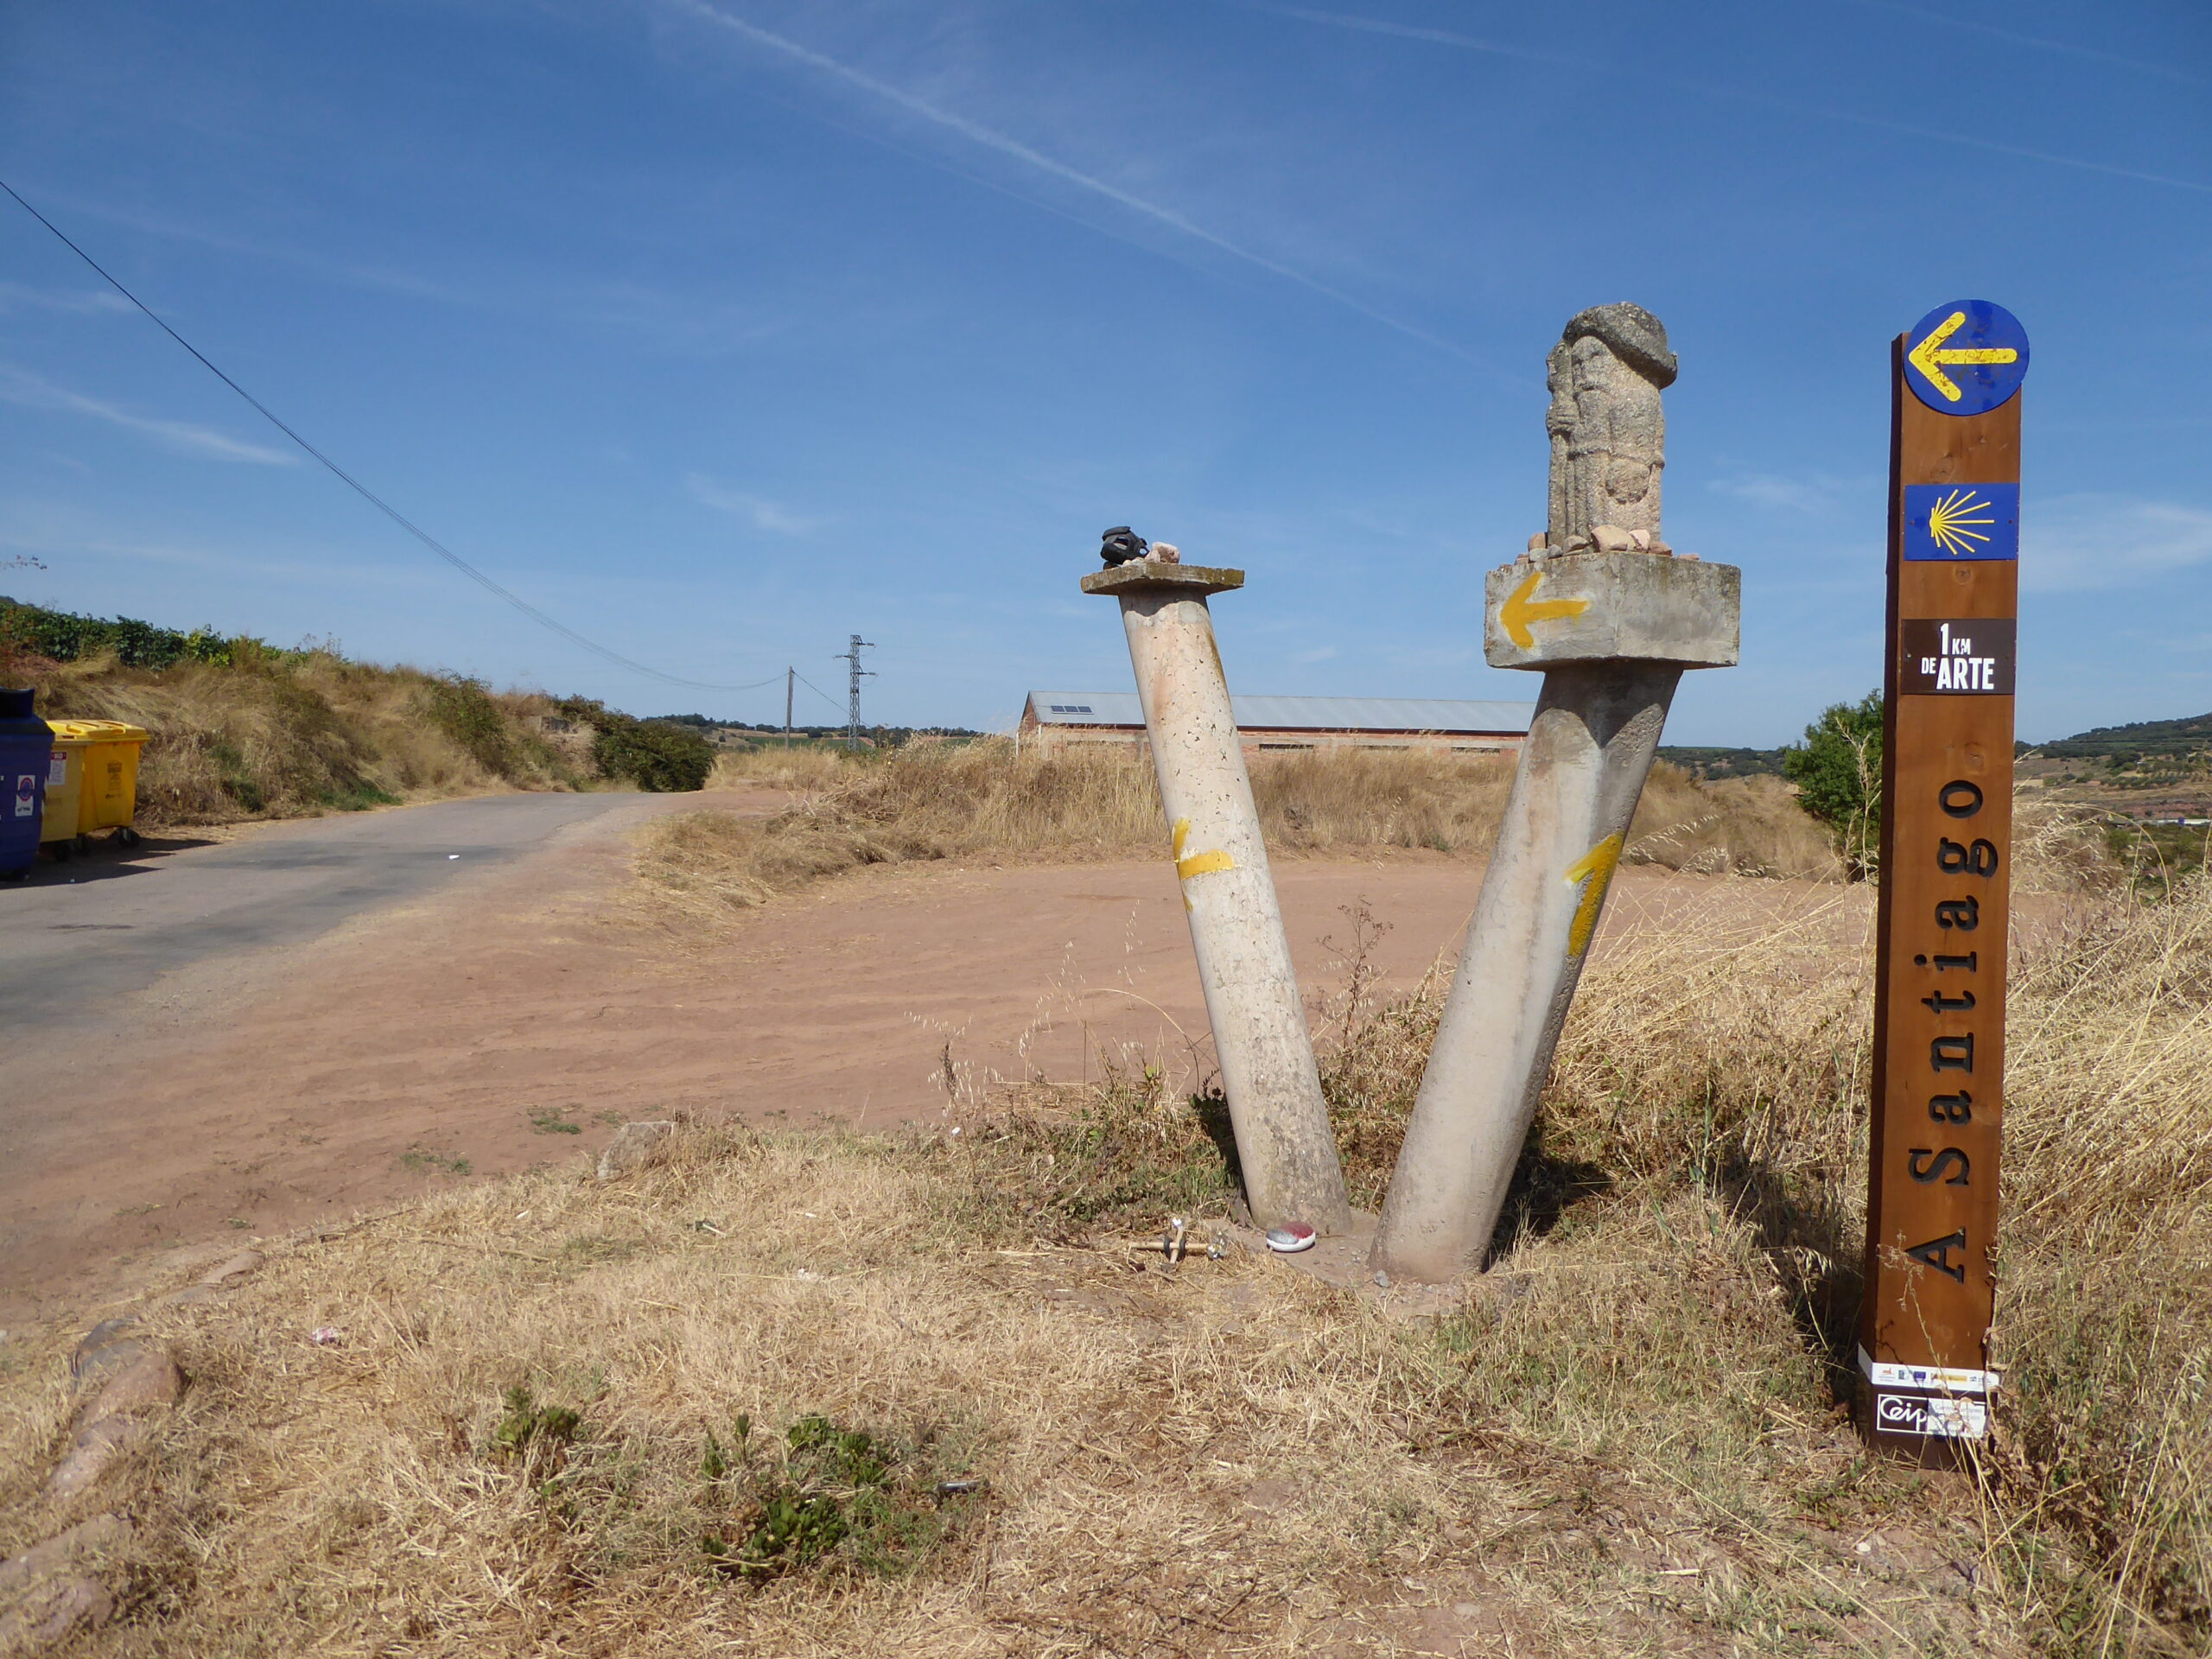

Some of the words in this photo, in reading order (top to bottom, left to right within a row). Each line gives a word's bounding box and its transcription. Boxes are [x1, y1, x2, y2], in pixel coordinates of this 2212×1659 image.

[1940, 623, 1949, 655] 1
[1951, 639, 1971, 655] KM
[1921, 657, 1936, 674] DE
[1936, 658, 1995, 690] ARTE
[1908, 779, 1999, 1187] Santiago
[1904, 1225, 1966, 1285] A
